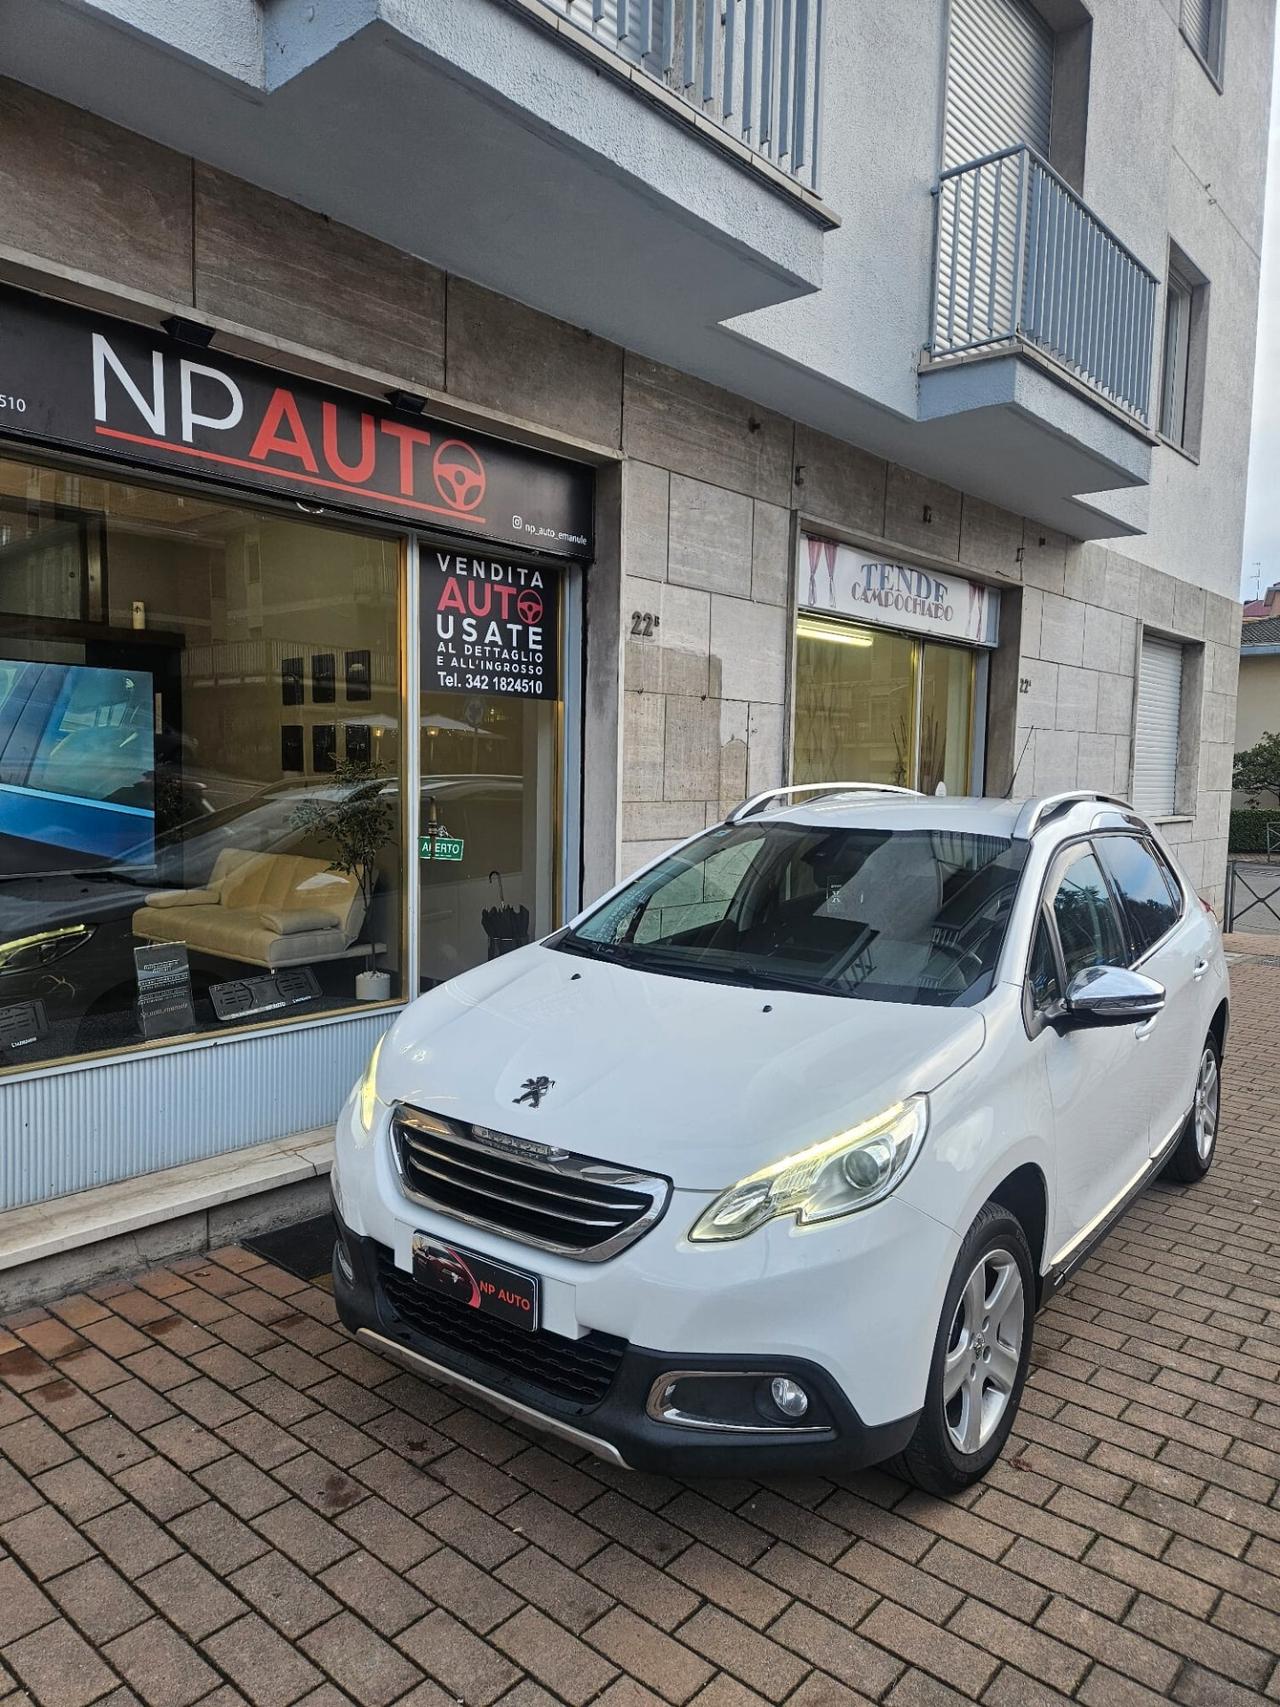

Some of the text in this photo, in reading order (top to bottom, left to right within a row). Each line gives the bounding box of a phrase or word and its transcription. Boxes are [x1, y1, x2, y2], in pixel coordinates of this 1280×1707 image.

[437, 553, 543, 589] VENDITA
[861, 563, 948, 603] TENDE
[851, 581, 954, 622] CAMPOCHIARO
[437, 614, 543, 650] USATE
[437, 642, 543, 663] AL DETTAGLIO
[437, 656, 543, 675] E ALL'INGROSSO
[437, 671, 543, 694] Tel. 342 1824510
[479, 1280, 531, 1311] NP AUTO
